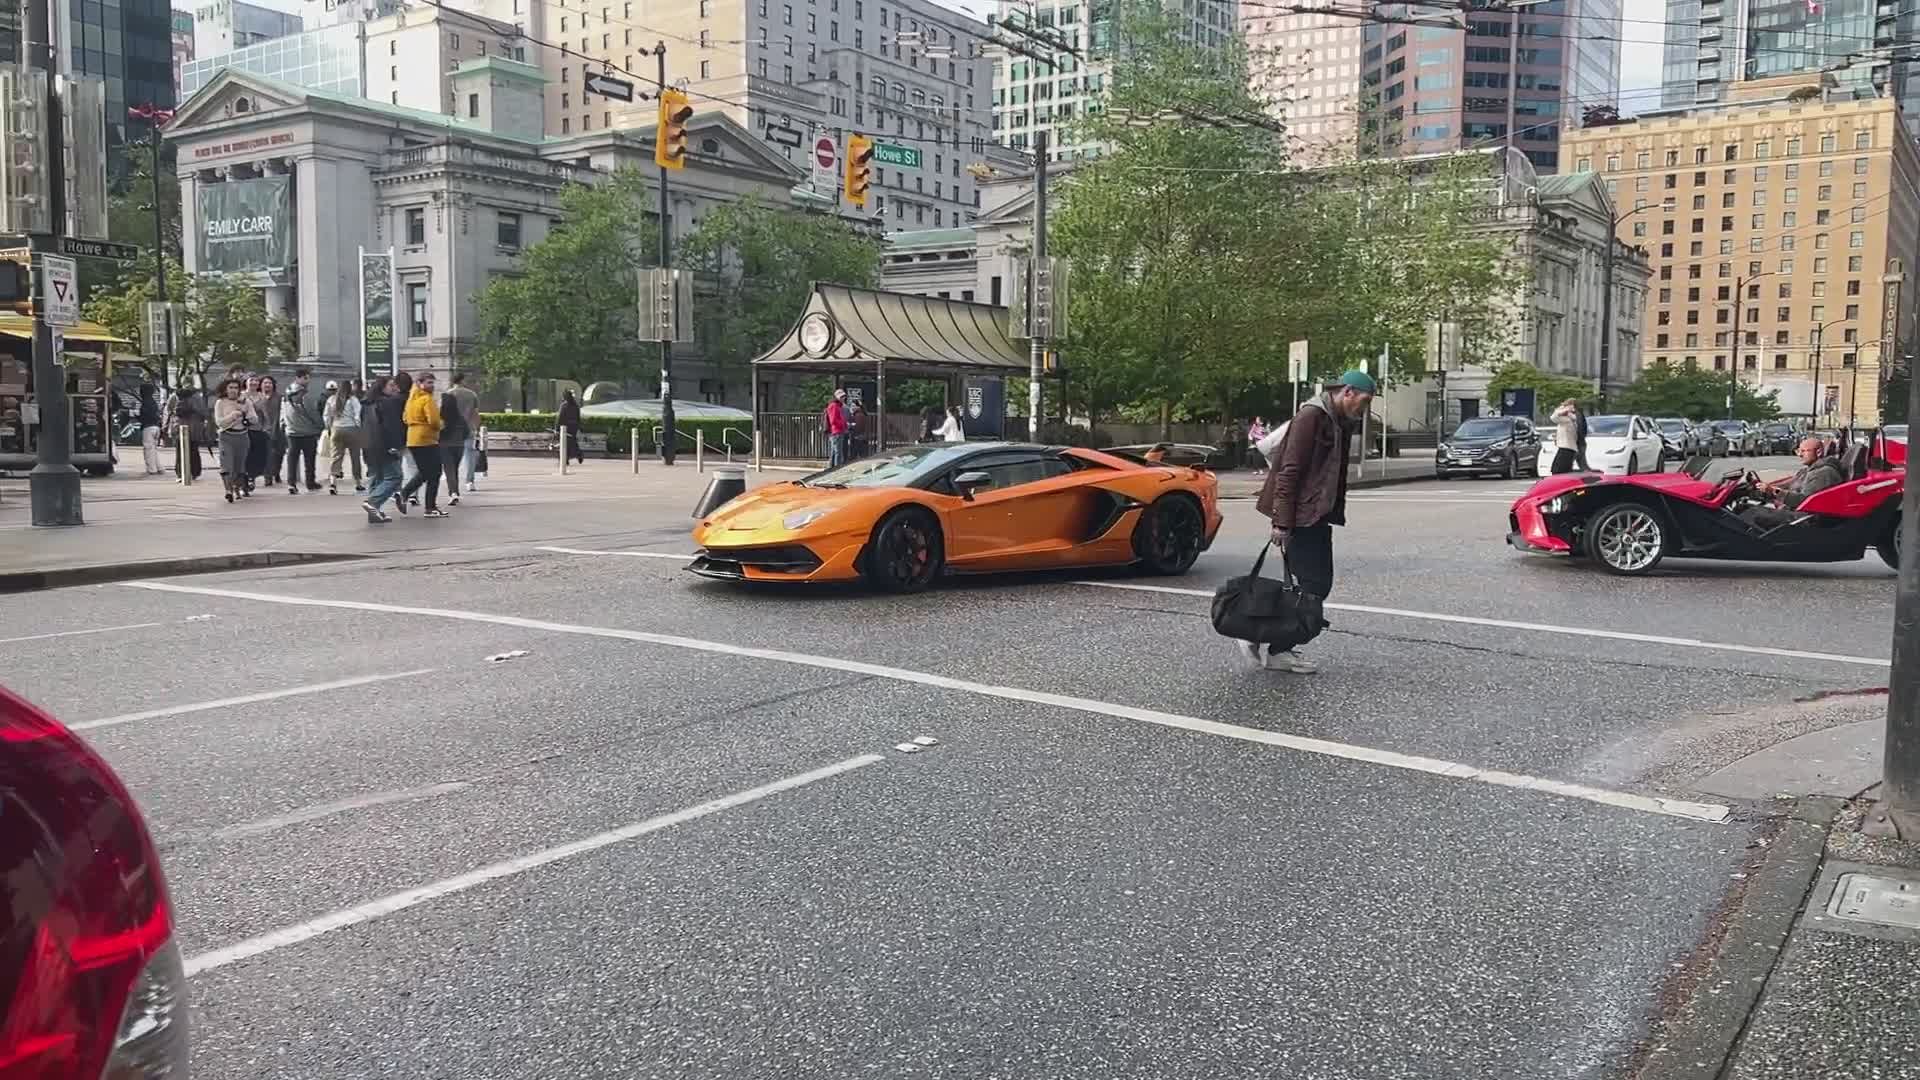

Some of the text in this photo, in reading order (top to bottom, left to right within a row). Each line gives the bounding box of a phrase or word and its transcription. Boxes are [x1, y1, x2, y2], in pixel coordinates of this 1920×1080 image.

[874, 145, 916, 165] Howe St
[208, 215, 273, 236] EMILY CARR
[67, 241, 102, 255] Howe
